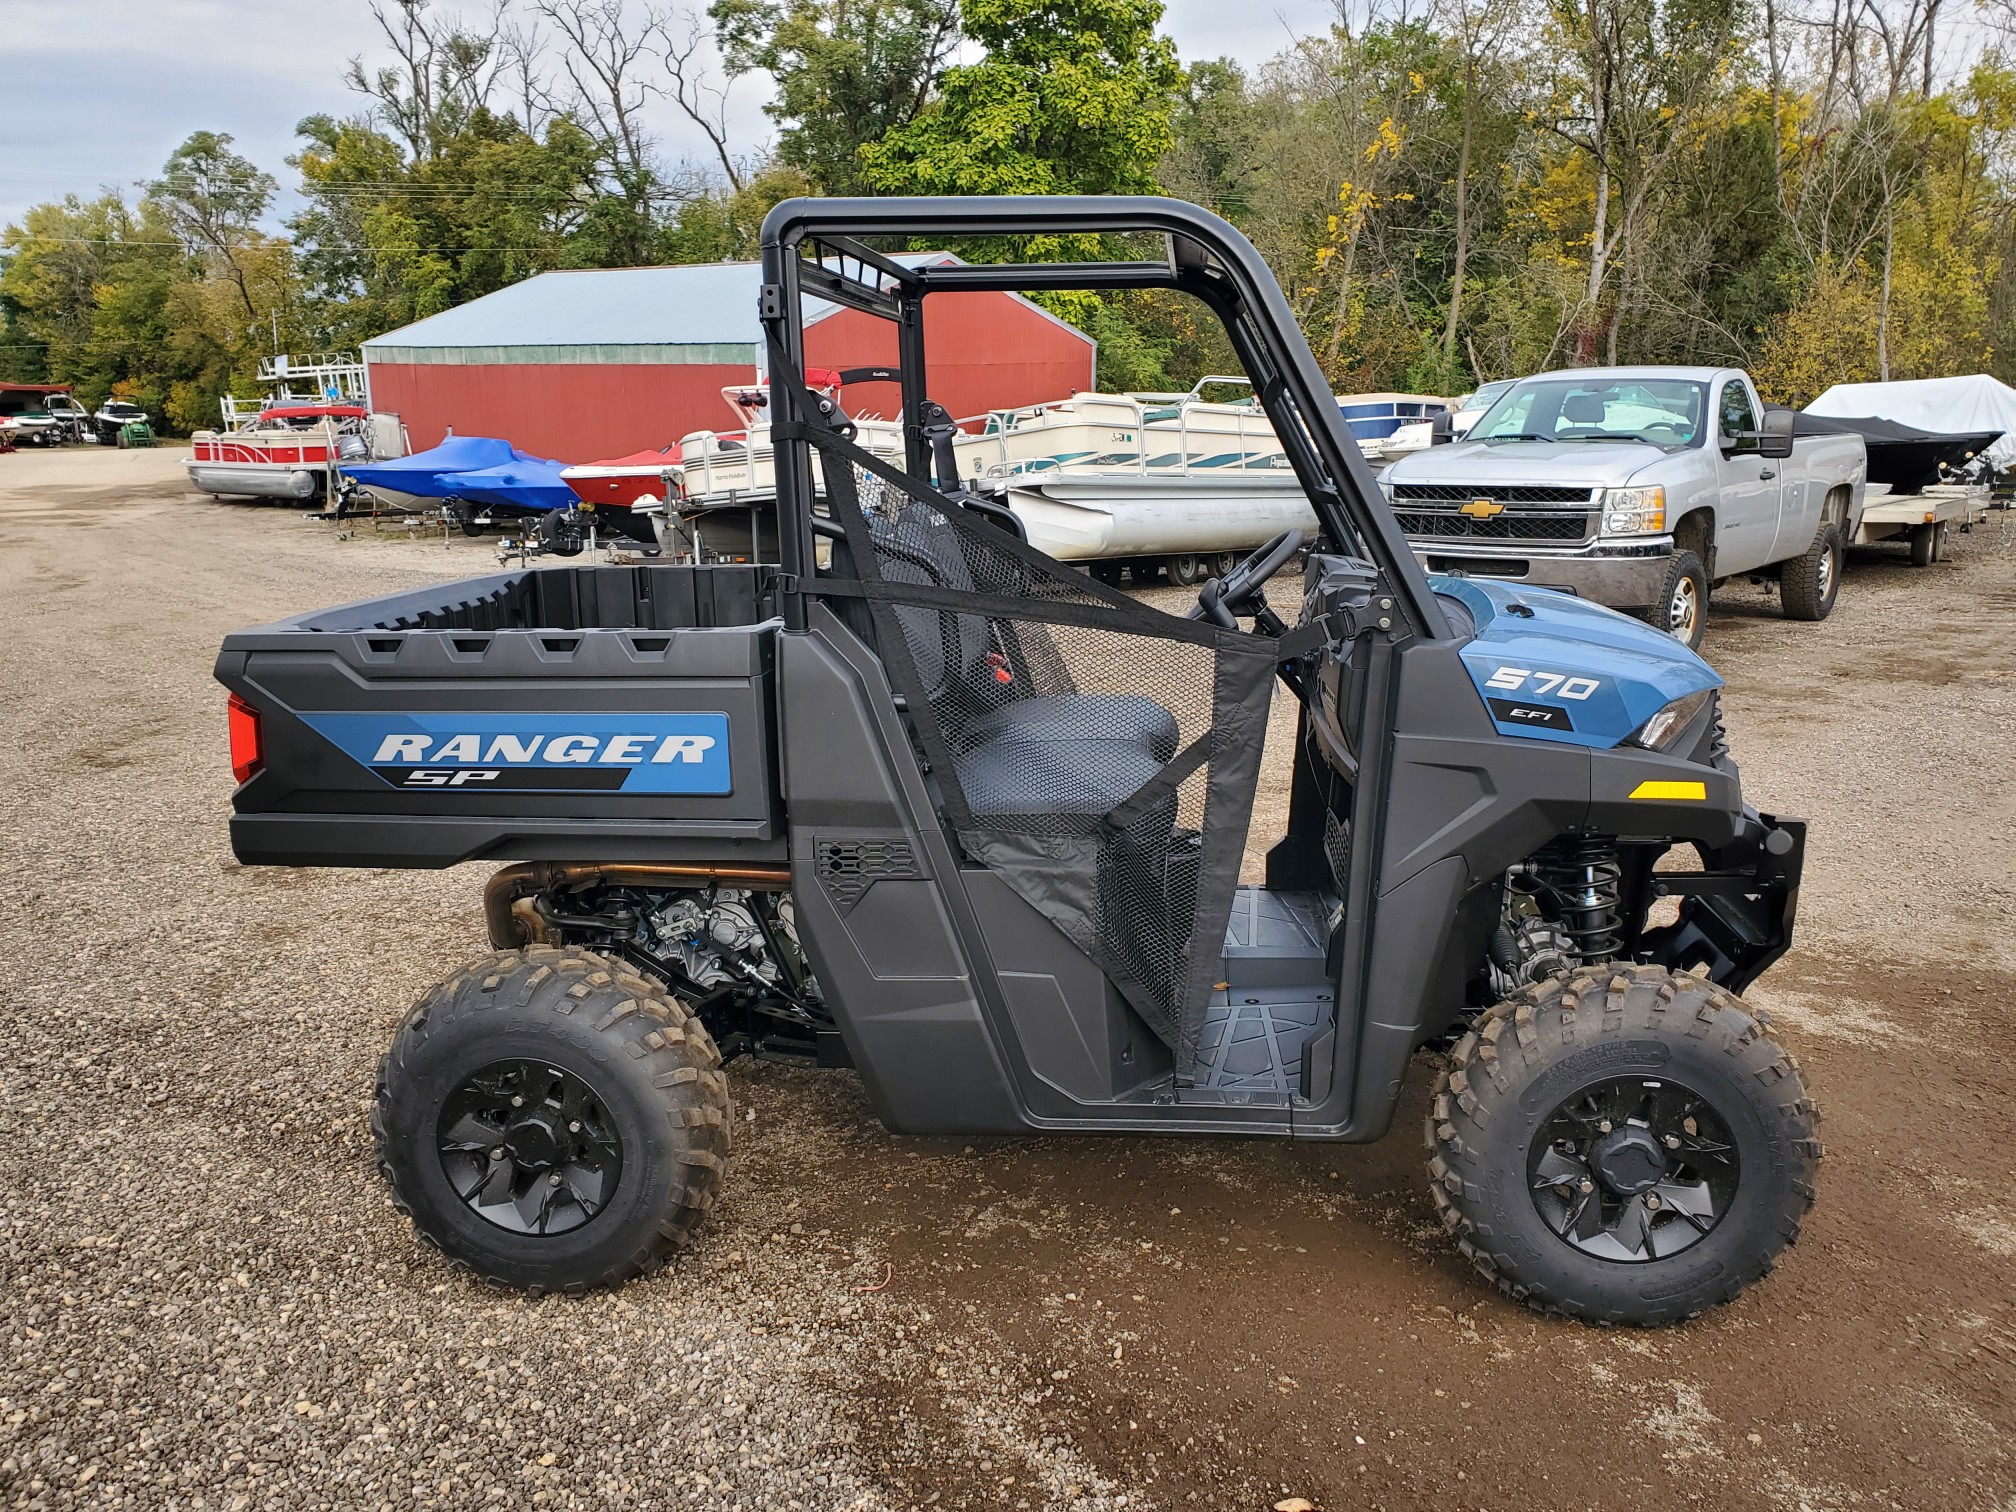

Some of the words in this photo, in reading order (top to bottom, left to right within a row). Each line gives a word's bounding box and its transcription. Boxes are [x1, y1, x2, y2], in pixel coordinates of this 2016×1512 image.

[1484, 666, 1600, 700] 570
[1510, 708, 1553, 721] EFI
[372, 734, 716, 764] RANGER
[403, 770, 501, 785] SP
